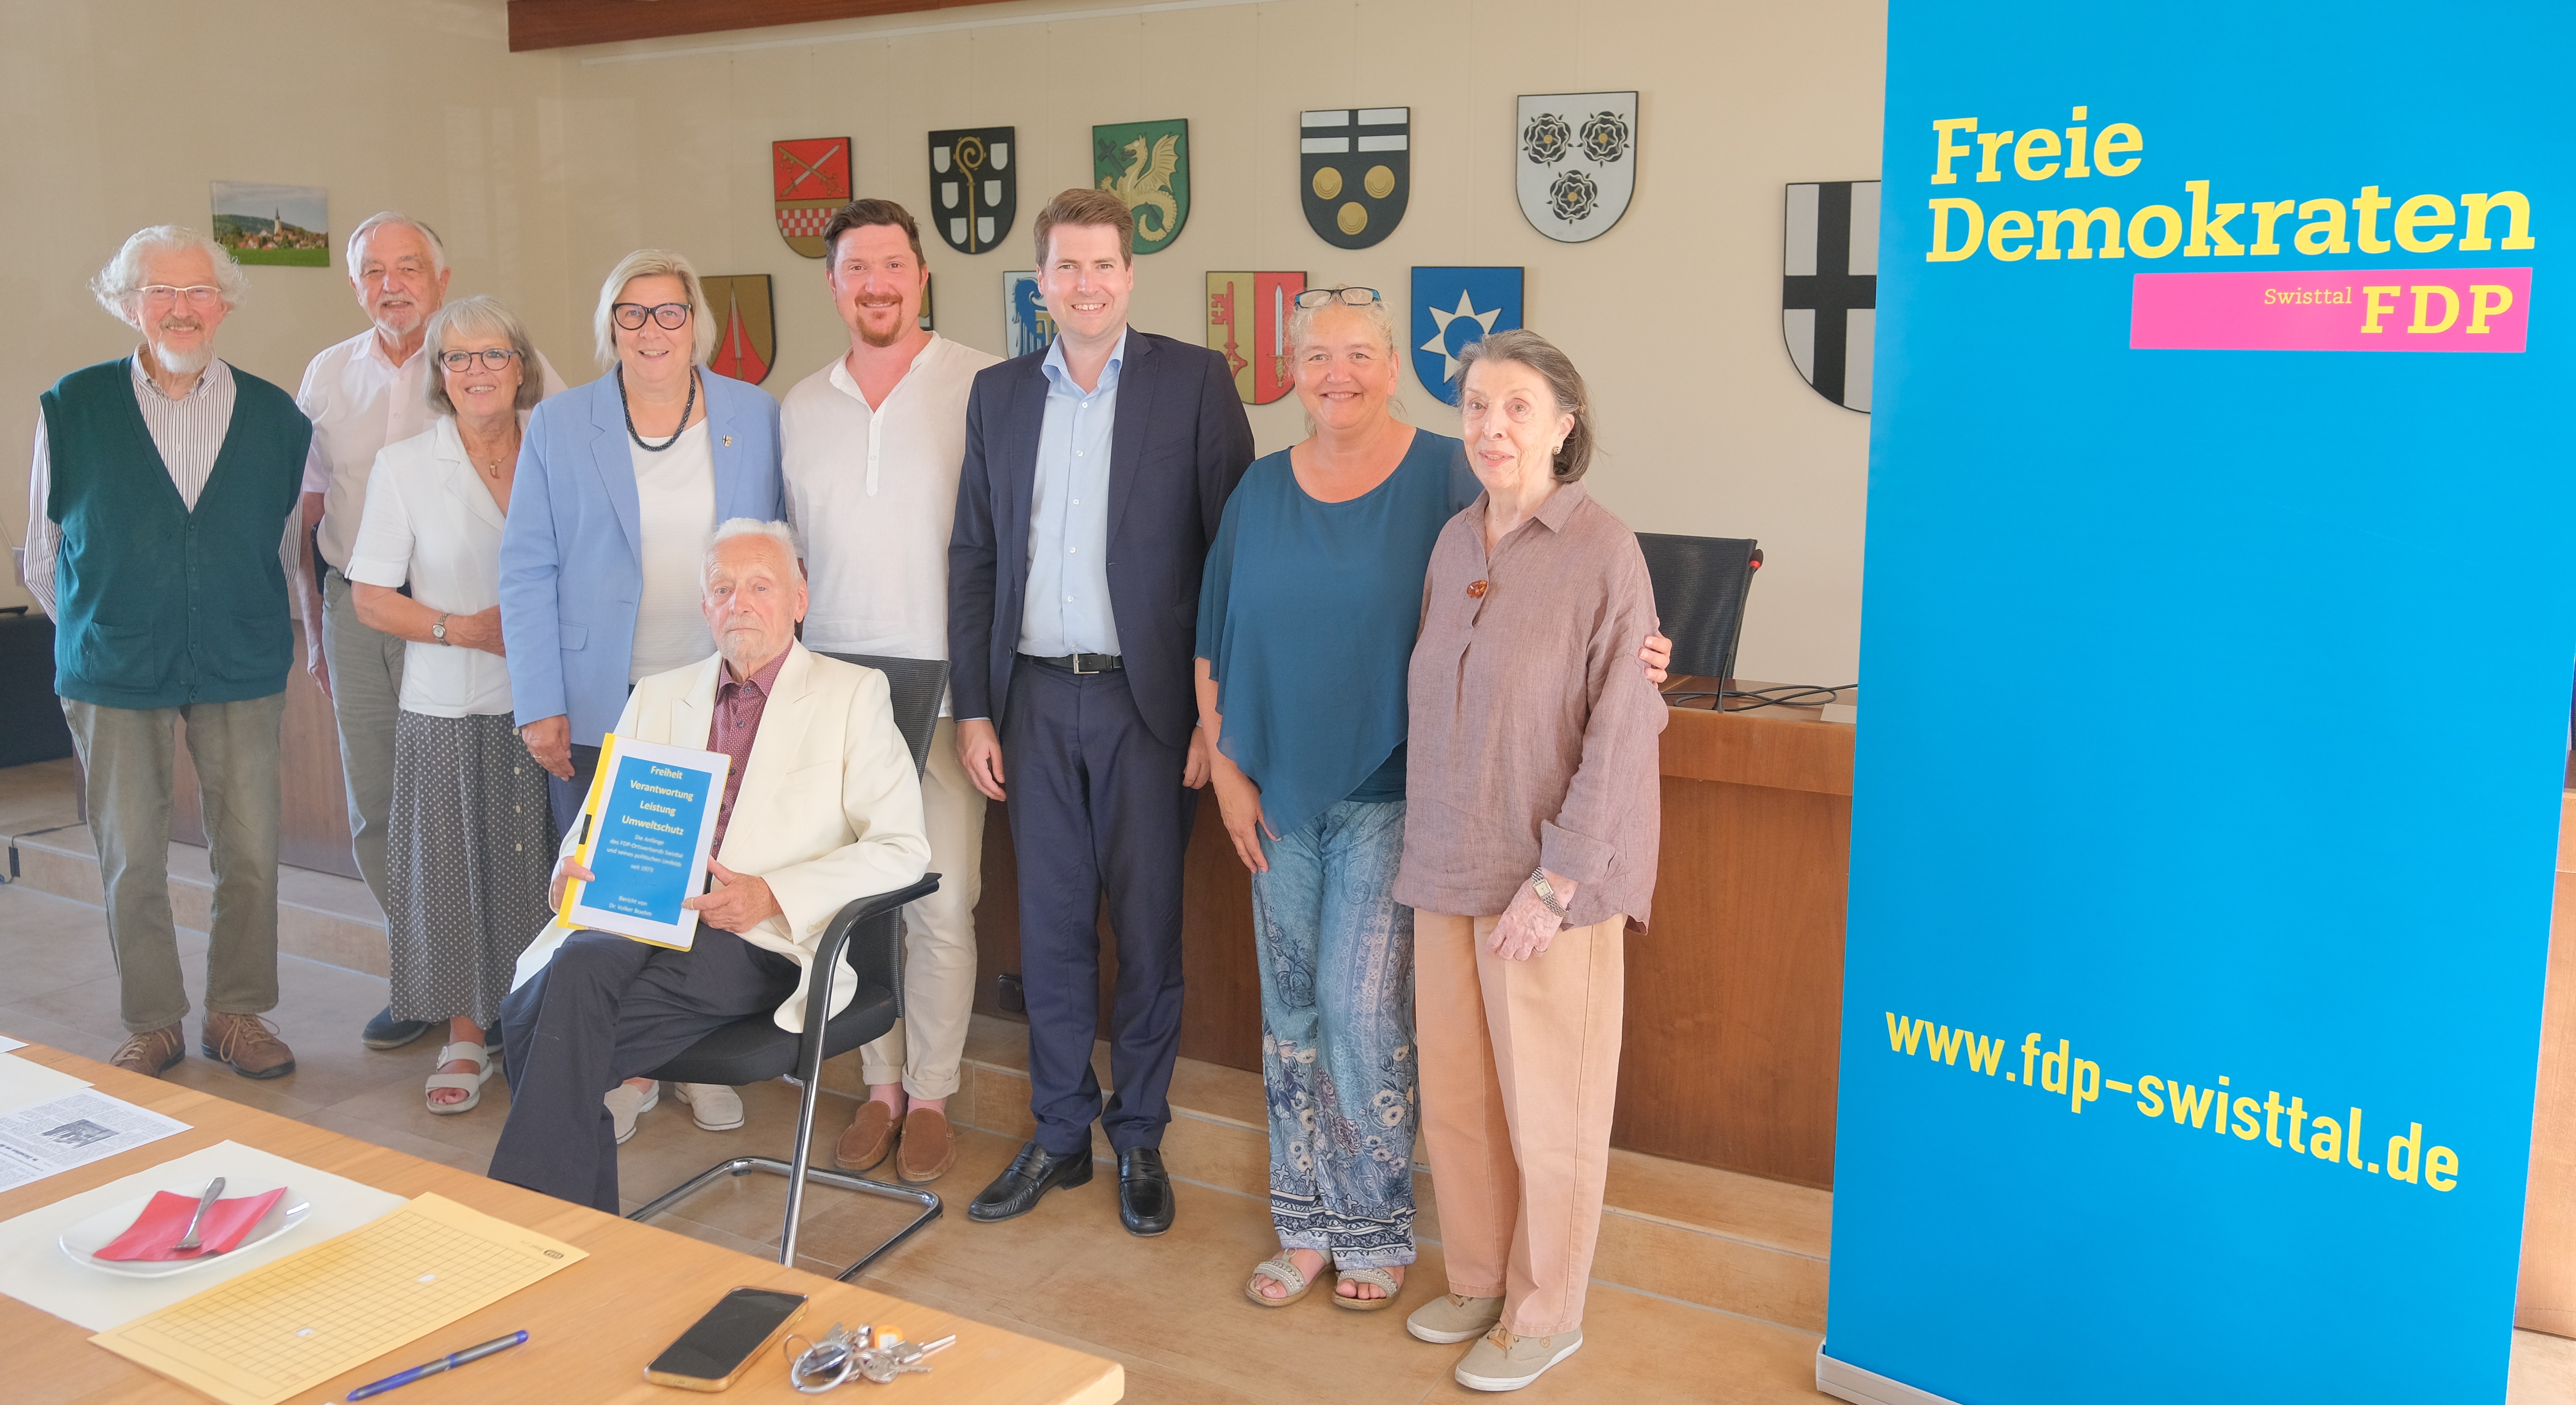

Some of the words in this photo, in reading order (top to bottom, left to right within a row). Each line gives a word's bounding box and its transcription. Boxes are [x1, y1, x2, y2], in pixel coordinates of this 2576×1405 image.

[1932, 106, 2142, 184] Freie
[1927, 177, 2535, 262] Demokraten
[2265, 286, 2351, 304] Swisttal
[2361, 285, 2513, 334] FDP
[651, 766, 683, 779] Freiheit
[630, 780, 693, 801] Verantwortung
[640, 801, 676, 817] Leistung
[622, 815, 684, 835] Umweltschutz
[634, 854, 661, 863] politischen
[634, 908, 652, 916] Boehm
[1887, 1012, 2458, 1191] www.fdp-swisttal.de
